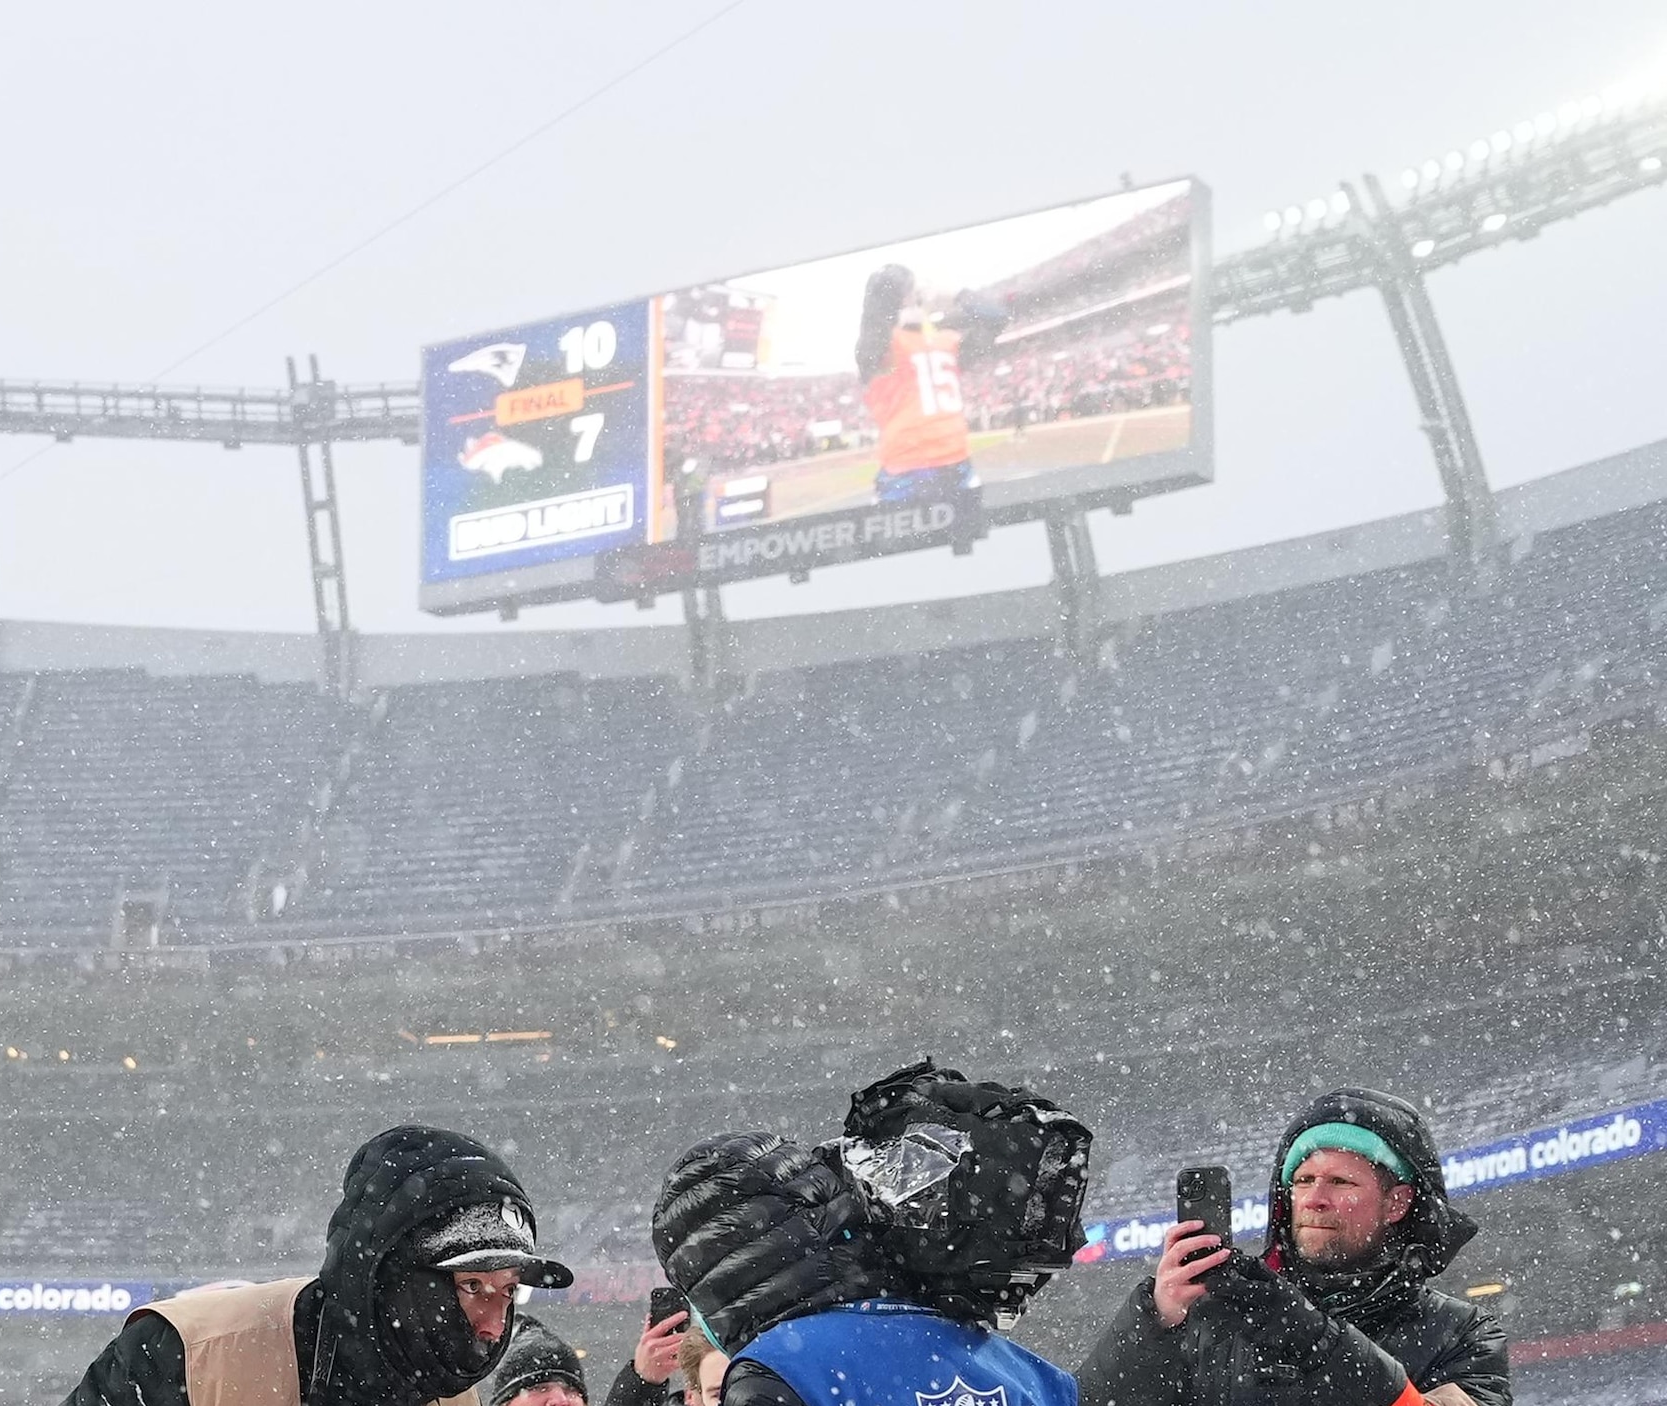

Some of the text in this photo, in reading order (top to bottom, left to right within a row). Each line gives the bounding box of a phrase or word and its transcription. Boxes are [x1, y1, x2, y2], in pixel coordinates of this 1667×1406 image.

[558, 320, 617, 373] 10
[509, 387, 570, 416] FINAL
[911, 350, 964, 418] 15
[571, 412, 605, 463] 7
[697, 502, 956, 573] EMPOWER FIELD
[1530, 1113, 1642, 1169] colorado
